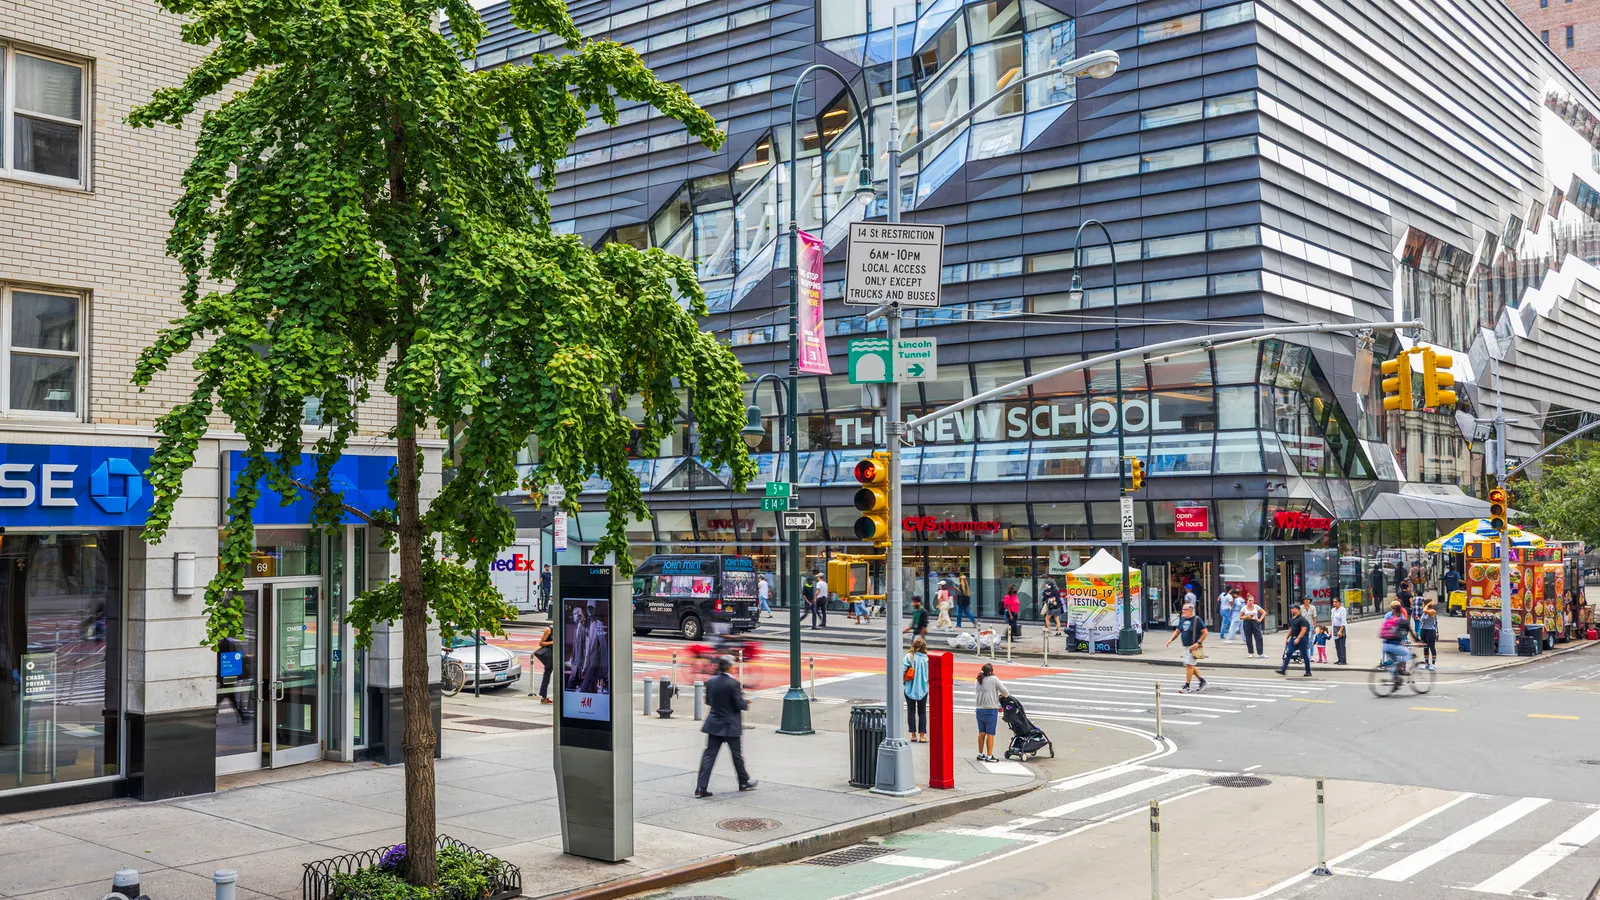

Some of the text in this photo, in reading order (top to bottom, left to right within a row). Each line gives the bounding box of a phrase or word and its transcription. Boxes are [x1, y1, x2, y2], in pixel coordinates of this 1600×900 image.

[858, 228, 935, 240] 14 St RESTRICTION
[862, 263, 927, 275] LOCAL ACCESS
[864, 276, 922, 287] ONLY EXCEPT
[850, 288, 936, 301] TRUCKS AND BUSES
[898, 340, 932, 349] Lincoln
[898, 350, 931, 359] Tunnel
[907, 408, 1002, 443] NEW
[1007, 398, 1183, 438] SCHOOL
[774, 484, 778, 494] 5
[764, 499, 768, 510] E
[772, 499, 778, 508] 14
[902, 515, 1001, 535] CVS pharmacy
[1123, 515, 1133, 528] 25
[1176, 520, 1204, 528] 24 hours
[257, 563, 268, 572] 69
[1069, 587, 1113, 598] COVID-19
[1318, 588, 1332, 599] CVS
[1073, 597, 1107, 608] TESTING
